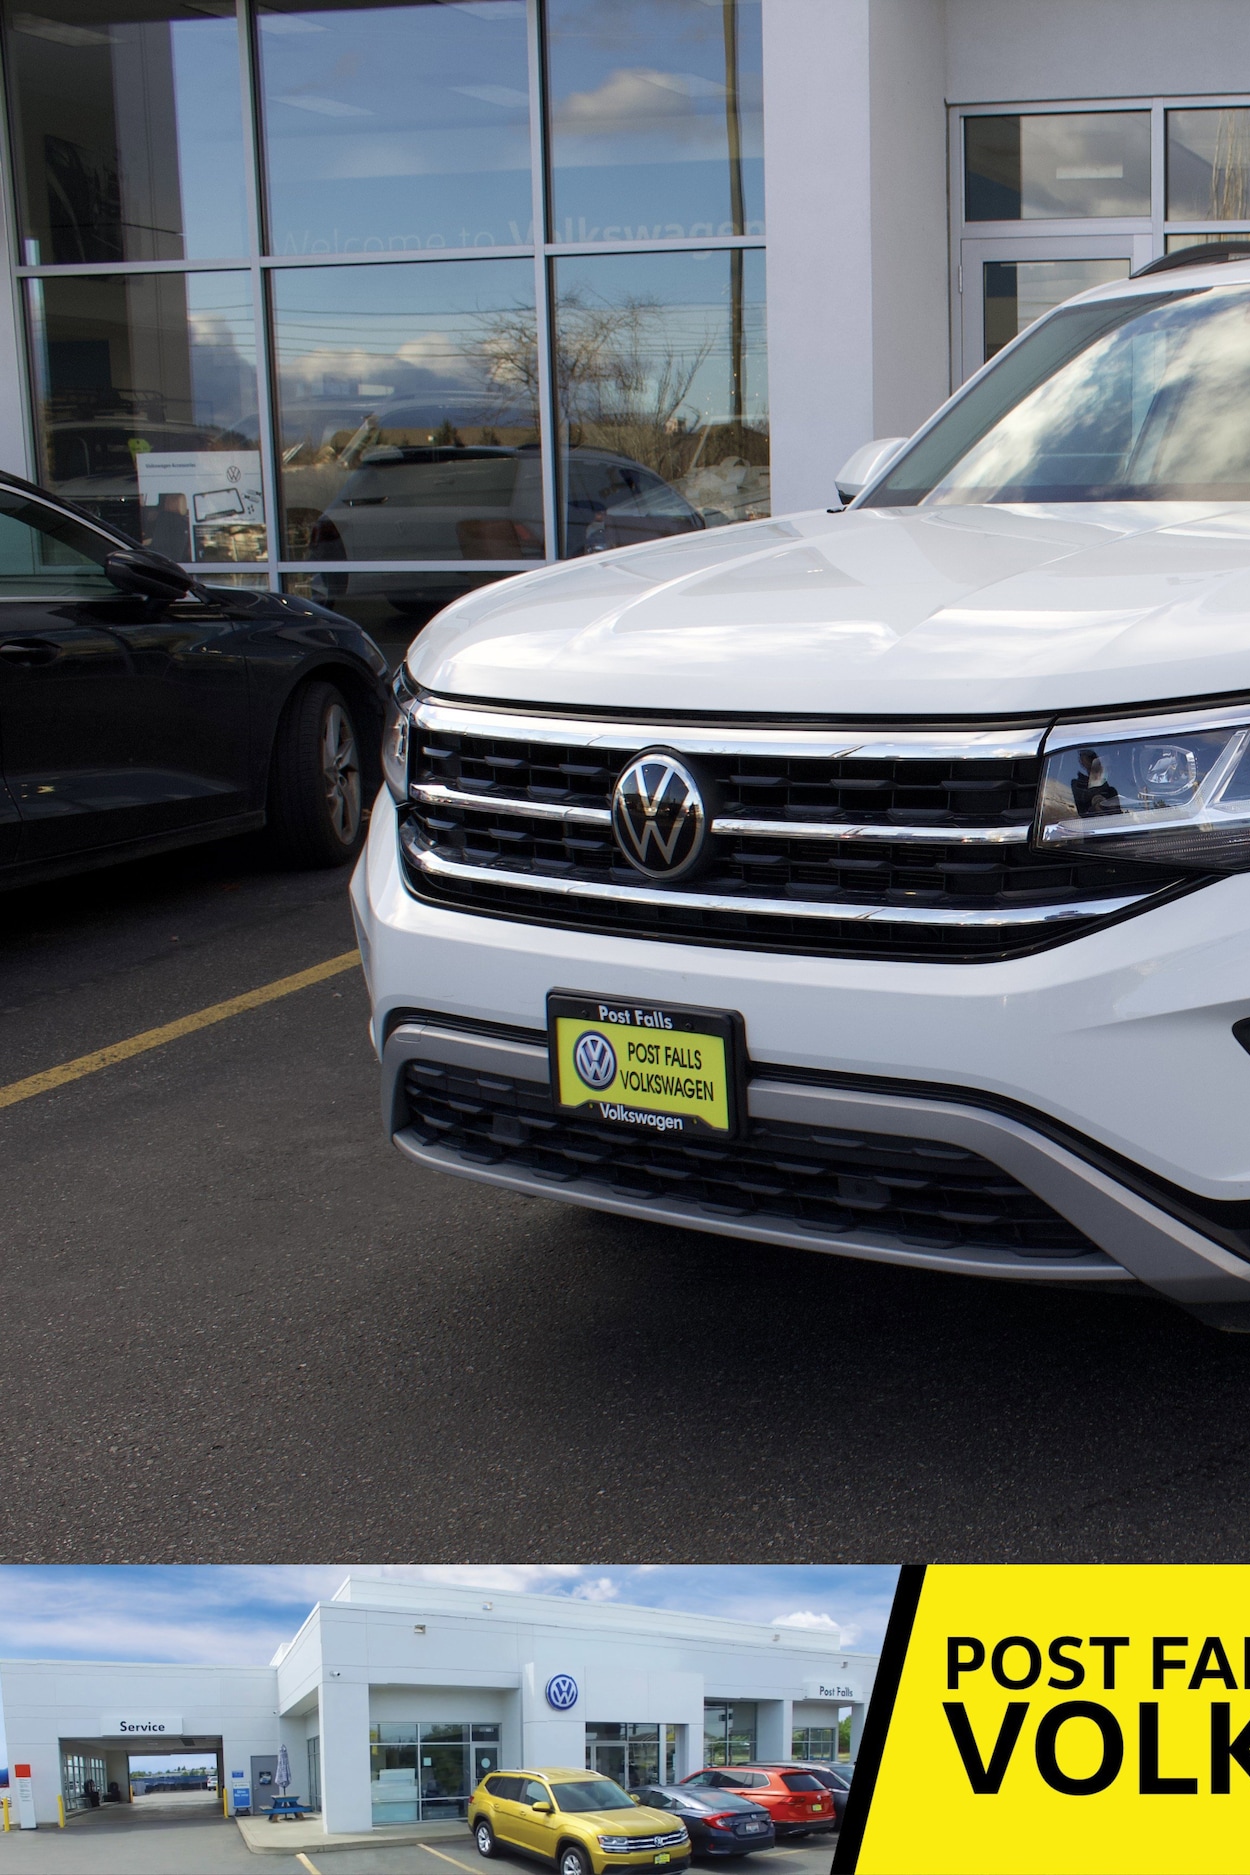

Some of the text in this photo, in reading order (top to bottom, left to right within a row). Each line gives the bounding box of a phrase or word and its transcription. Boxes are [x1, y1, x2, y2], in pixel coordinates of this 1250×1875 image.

[612, 753, 705, 879] VW
[599, 1005, 673, 1029] Post Falls
[628, 1042, 702, 1070] POST FALLS
[620, 1070, 714, 1101] VOLKSWAGEN
[600, 1102, 683, 1131] Volkswagen
